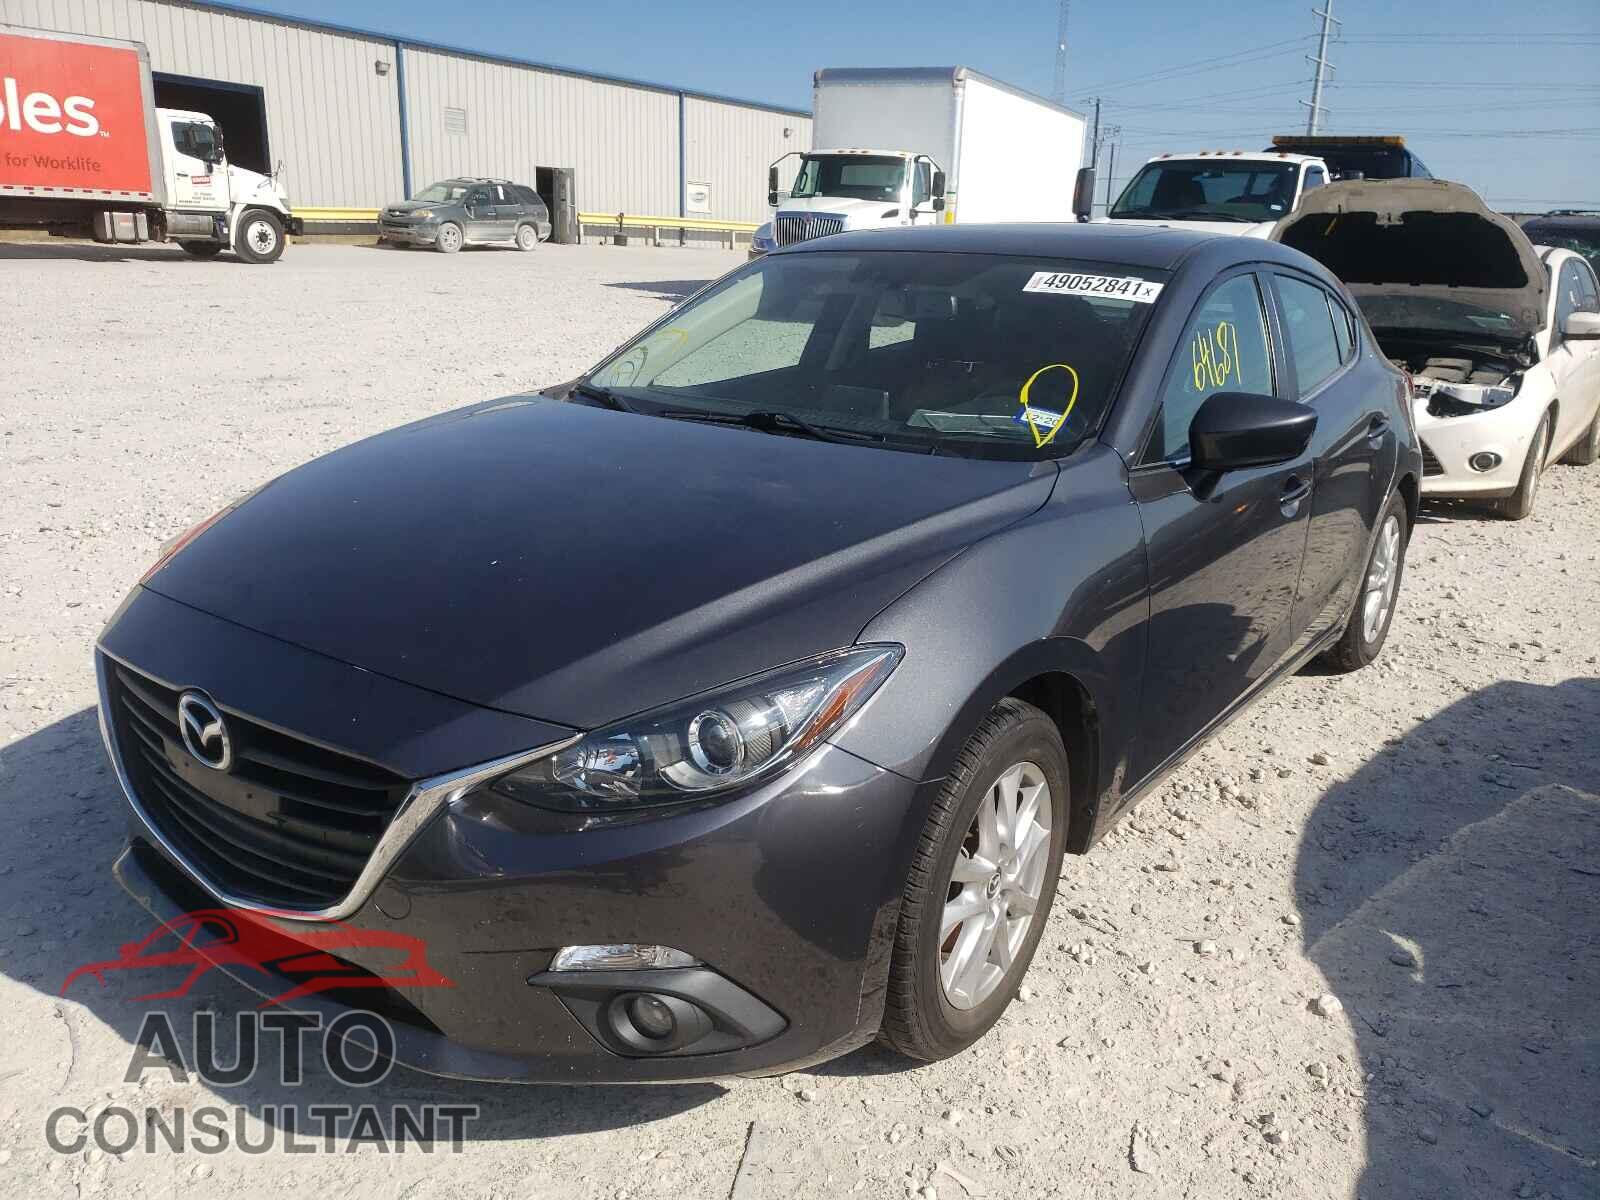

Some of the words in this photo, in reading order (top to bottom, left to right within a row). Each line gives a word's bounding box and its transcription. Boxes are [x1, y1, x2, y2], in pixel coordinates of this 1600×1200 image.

[4, 152, 28, 167] for
[33, 154, 101, 171] Worklife
[1043, 274, 1143, 296] 49052841
